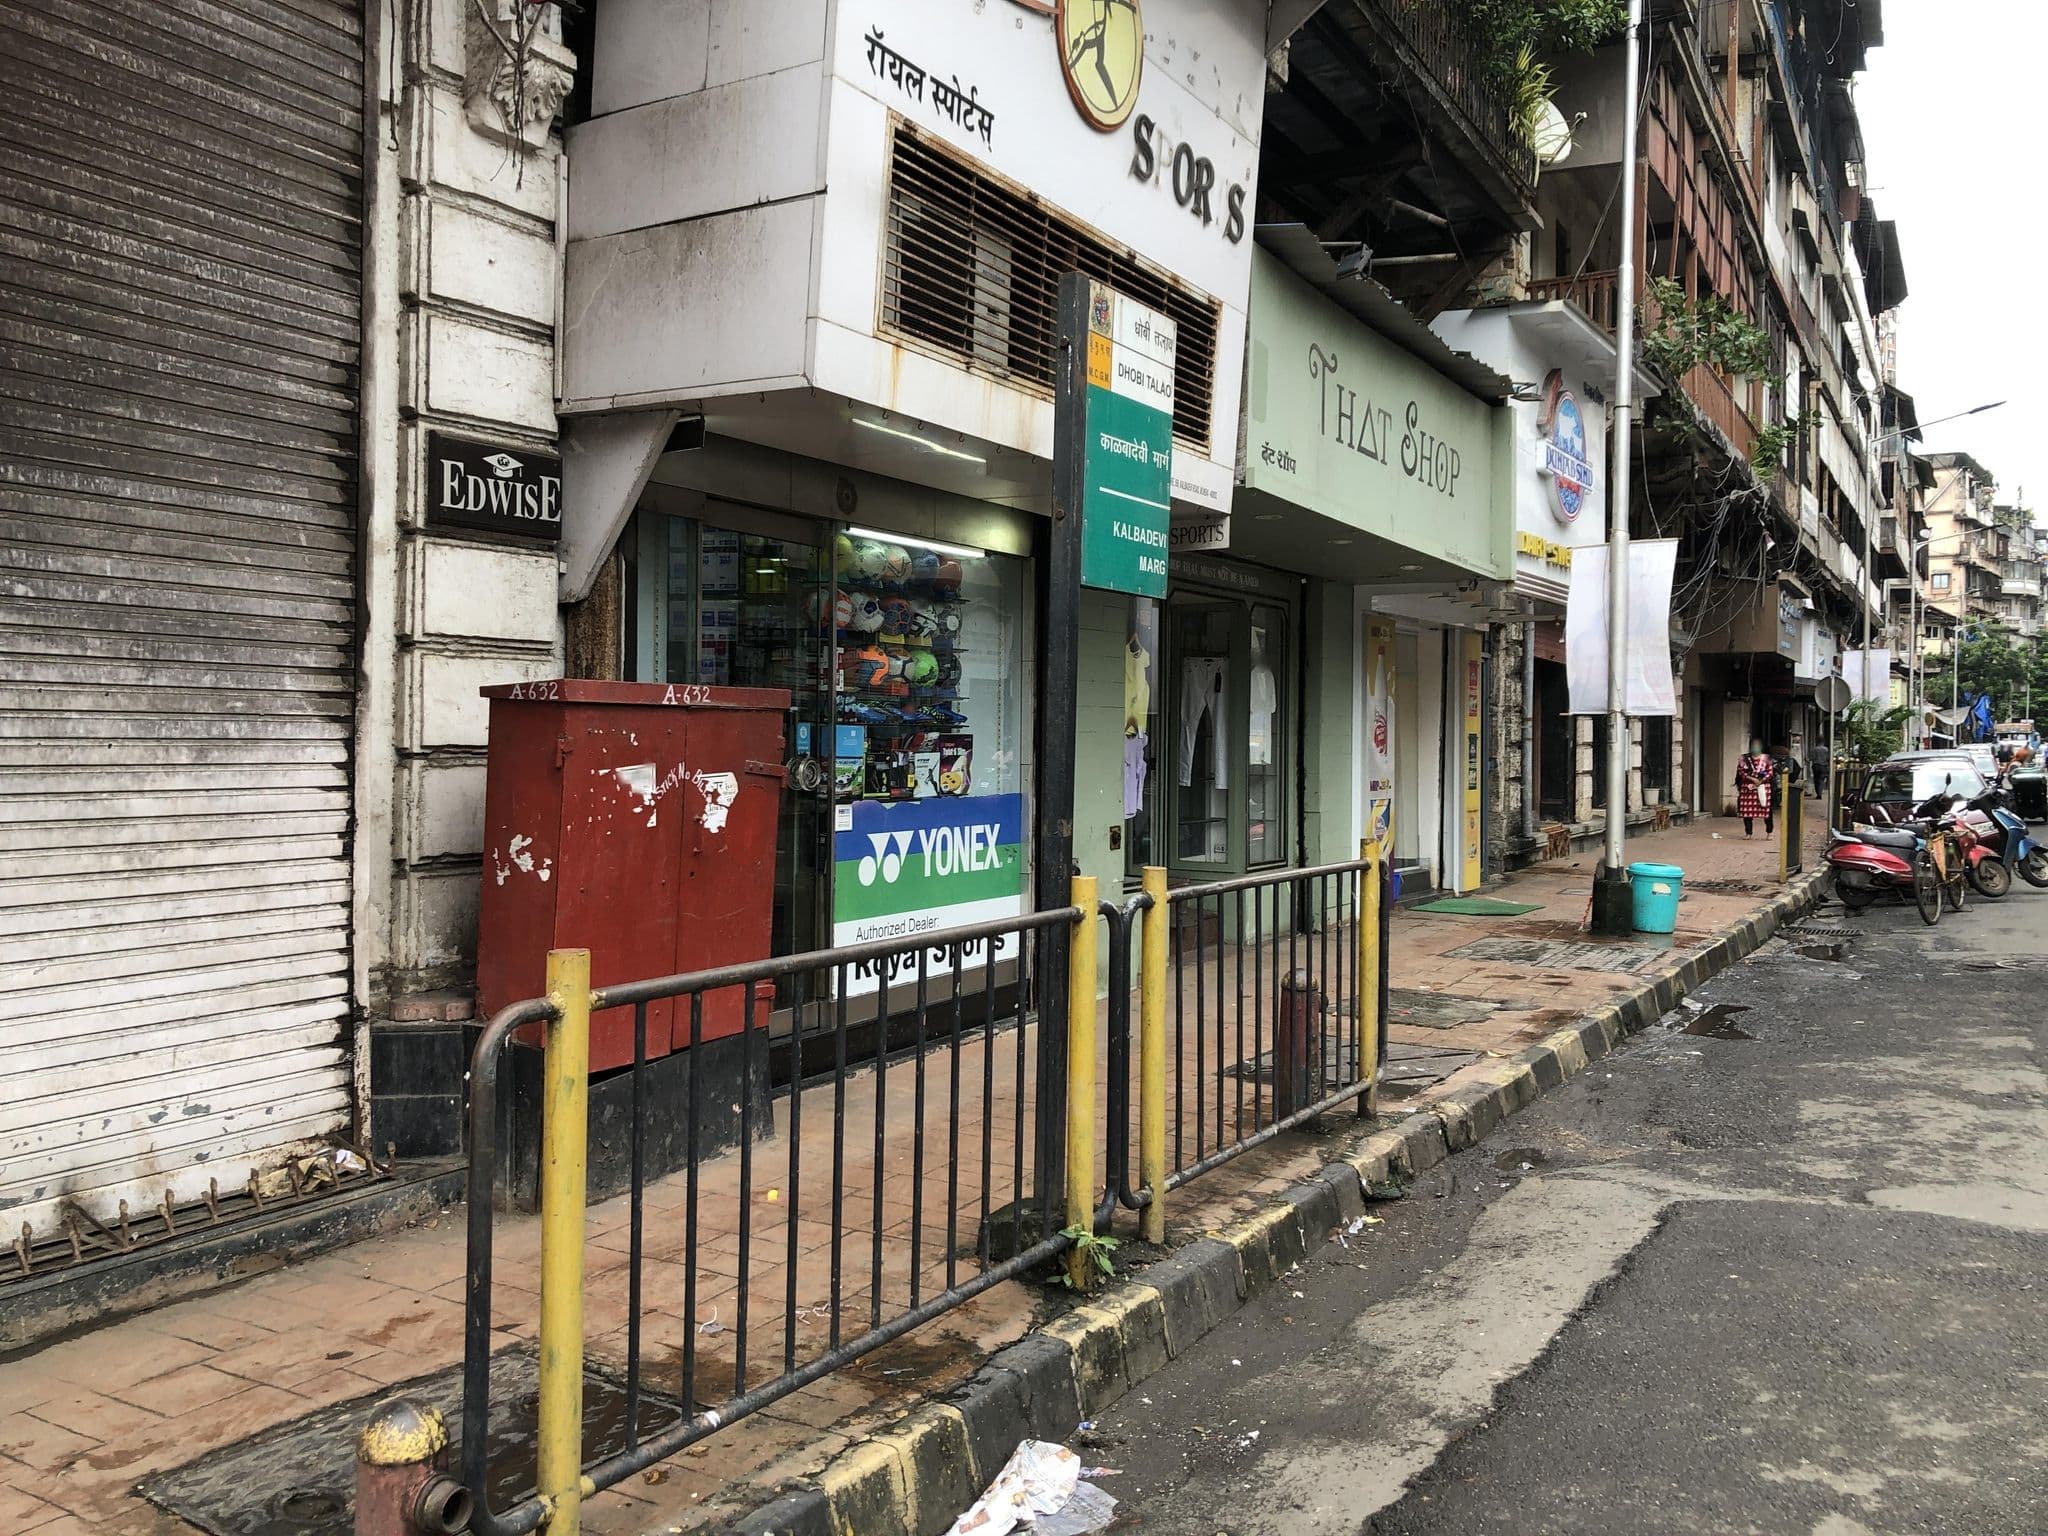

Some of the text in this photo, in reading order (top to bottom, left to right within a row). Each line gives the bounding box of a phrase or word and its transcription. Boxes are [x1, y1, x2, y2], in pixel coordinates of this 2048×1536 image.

[864, 24, 926, 104] रॉयल
[1118, 363, 1172, 398] DHOBI TALAO
[1308, 342, 1462, 498] THAT SHOP
[1100, 432, 1170, 471] काळबादेवी मार्ग
[439, 459, 561, 523] EDWISE
[1113, 520, 1168, 549] KALBADEVI
[1170, 524, 1225, 545] SPORTS
[1139, 555, 1167, 575] MARG
[509, 682, 560, 700] A-632
[662, 684, 712, 705] A-632
[655, 768, 679, 800] STICK
[919, 823, 1001, 877] YONEX
[855, 915, 940, 942] Authorized Dealer:
